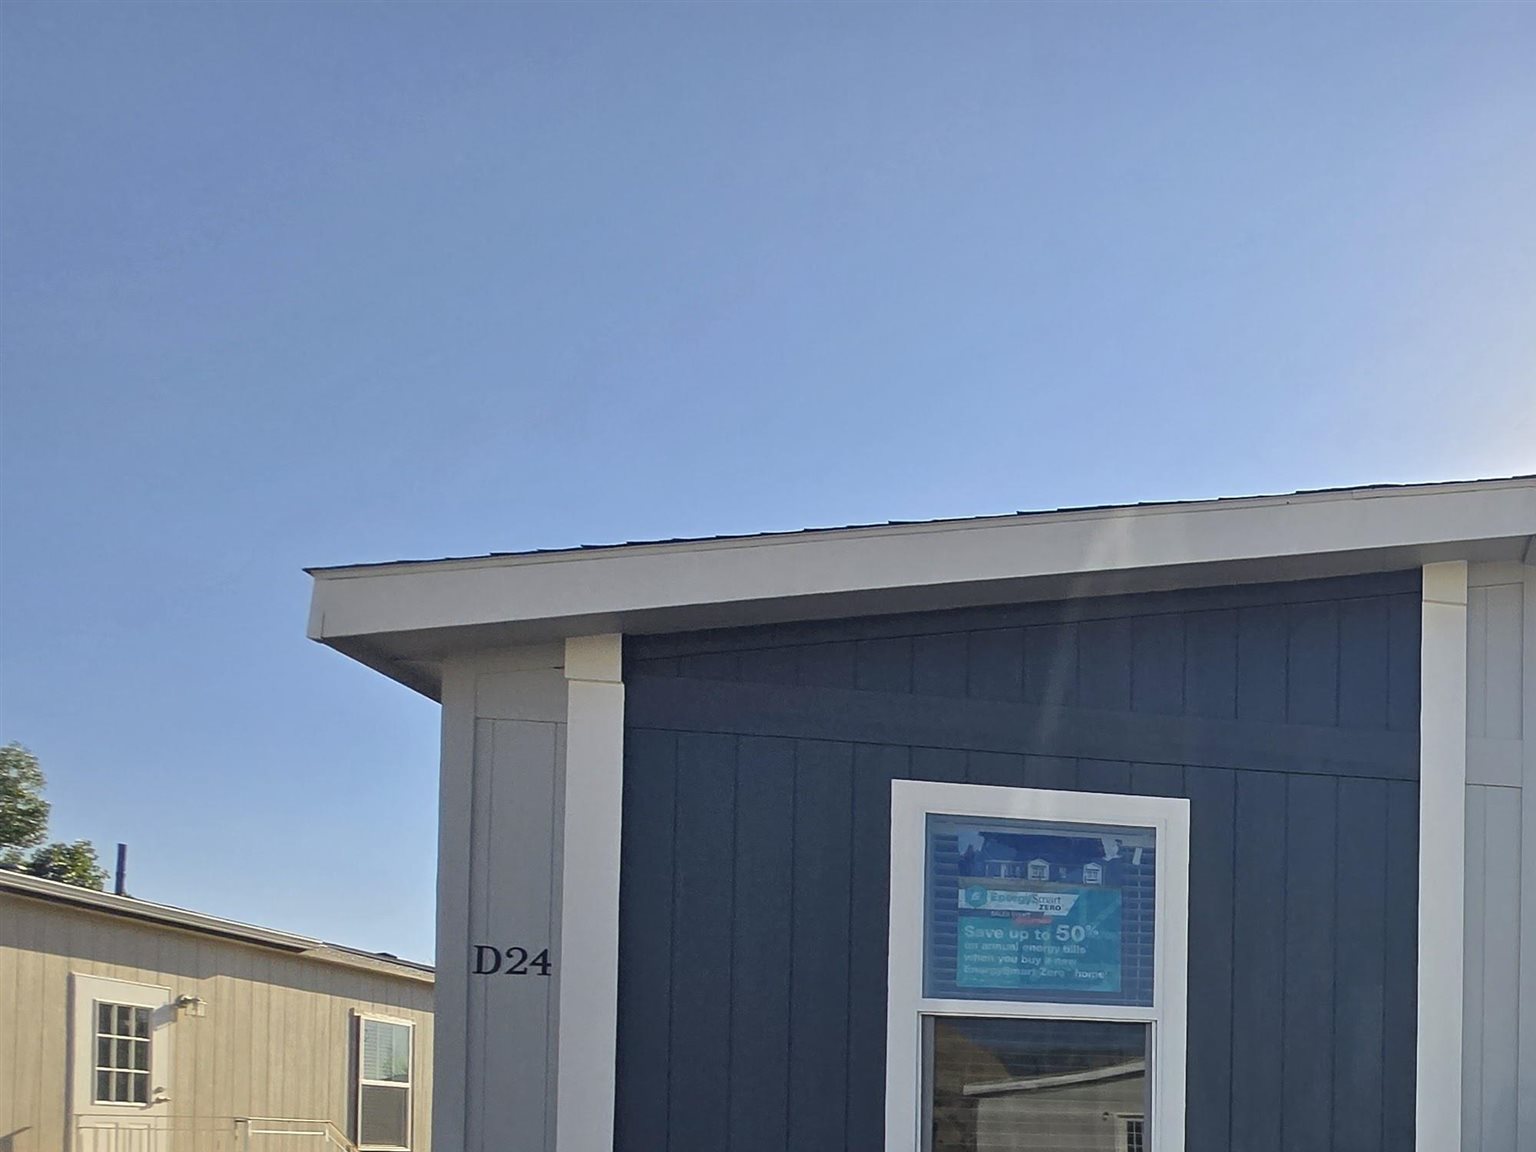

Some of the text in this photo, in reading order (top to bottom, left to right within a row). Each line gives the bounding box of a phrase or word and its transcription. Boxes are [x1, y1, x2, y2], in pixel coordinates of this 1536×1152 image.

[1038, 904, 1062, 912] ZERO
[964, 924, 1099, 942] Save up to 50%
[981, 942, 1019, 952] annual
[1022, 944, 1060, 954] energy
[473, 945, 552, 976] D24
[964, 954, 994, 963] when
[998, 955, 1018, 965] you
[1021, 955, 1042, 966] buy
